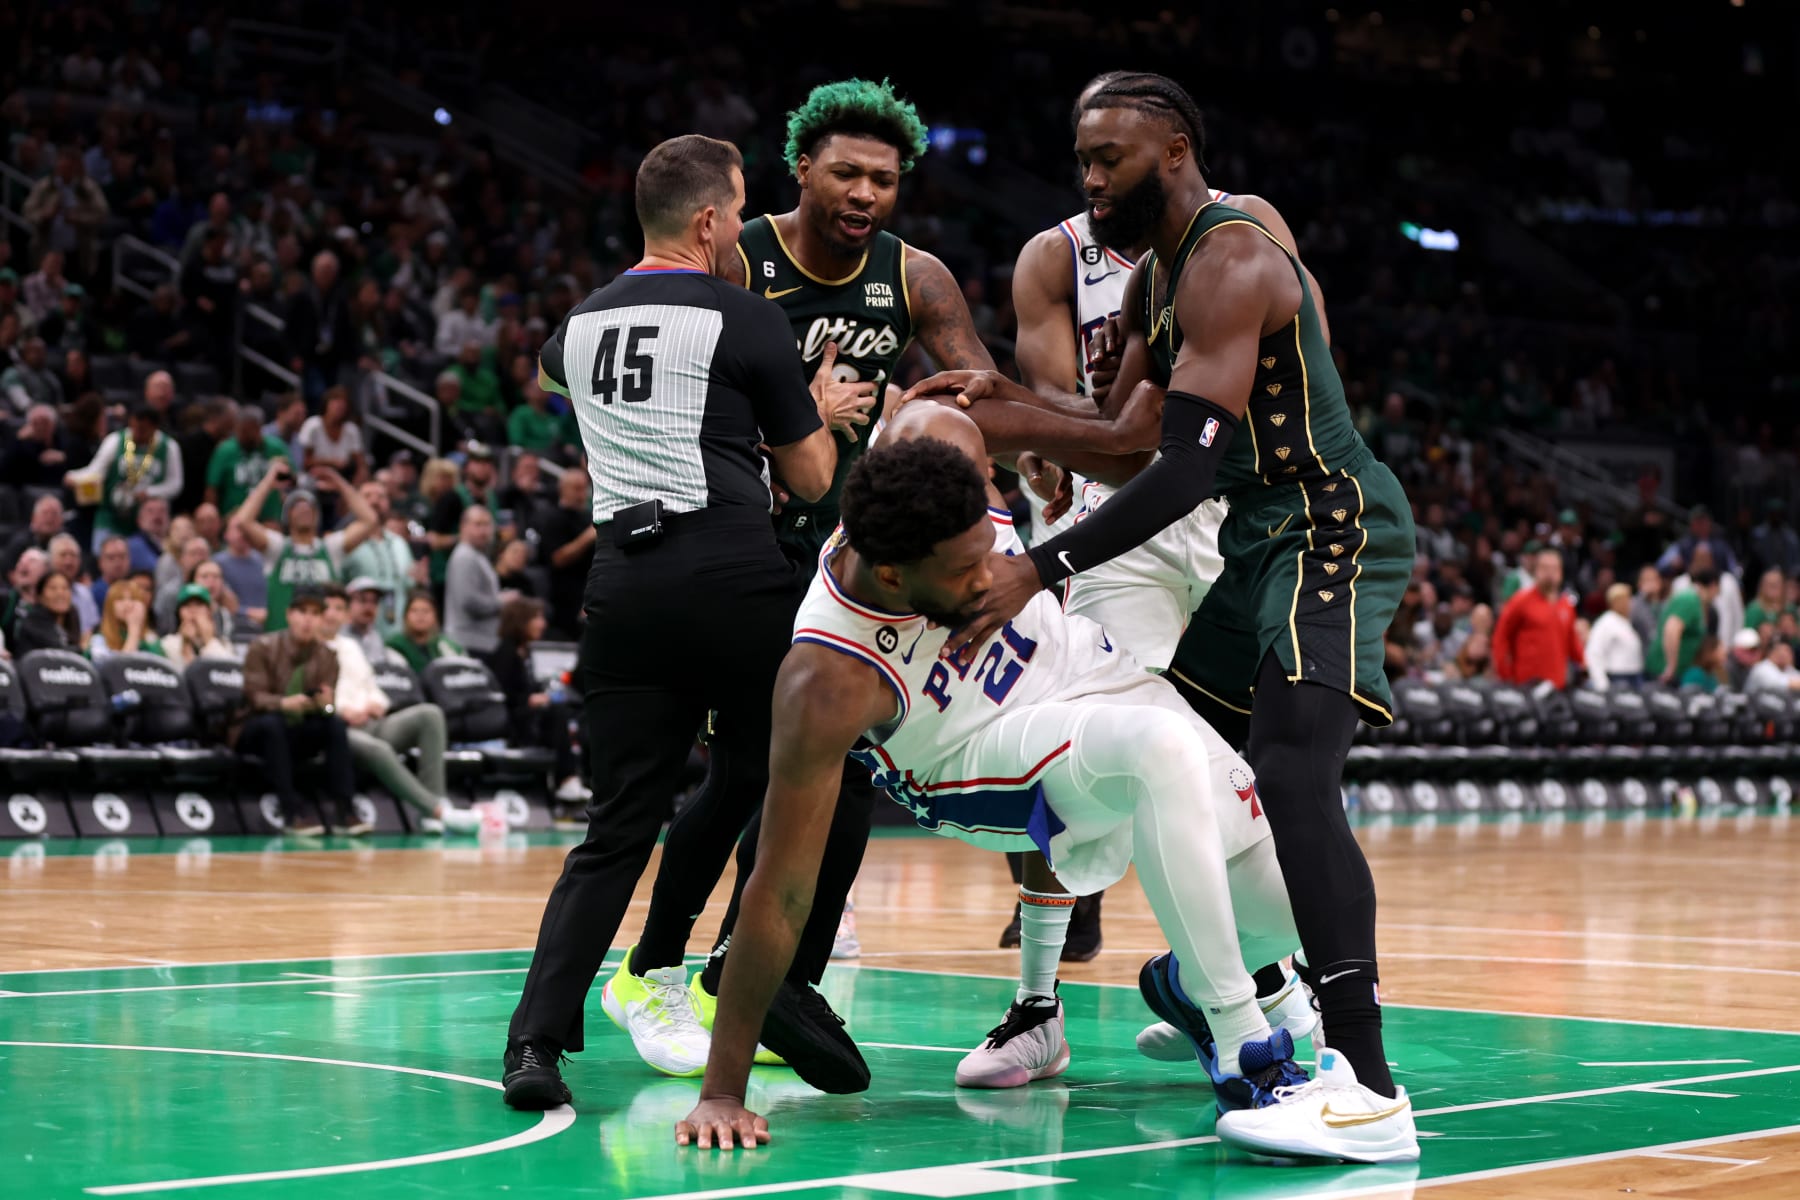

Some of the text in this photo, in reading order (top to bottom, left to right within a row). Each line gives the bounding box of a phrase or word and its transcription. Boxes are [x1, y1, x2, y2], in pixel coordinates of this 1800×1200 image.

[1085, 247, 1098, 261] 6
[763, 261, 776, 278] 6
[865, 283, 893, 297] VISTA
[866, 296, 894, 308] PRINT
[797, 317, 899, 363] ltics
[592, 326, 660, 404] 45
[879, 630, 896, 650] 6
[973, 620, 1038, 707] 21
